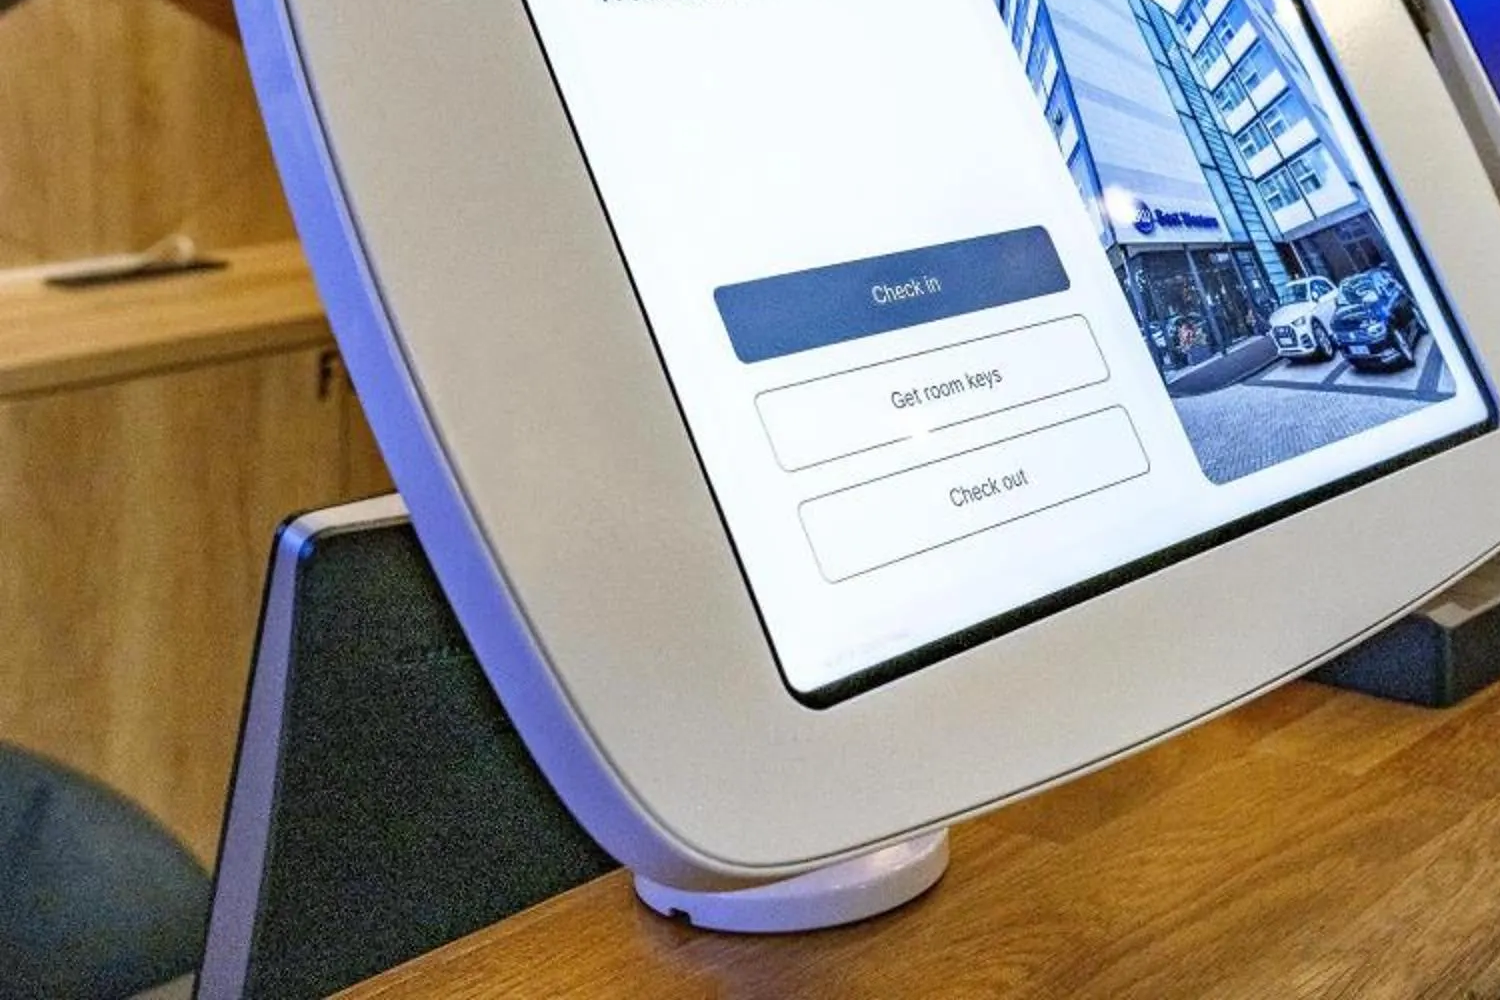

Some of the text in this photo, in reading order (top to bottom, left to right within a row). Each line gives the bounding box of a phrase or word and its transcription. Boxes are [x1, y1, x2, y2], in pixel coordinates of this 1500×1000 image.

[871, 276, 942, 304] Check in
[891, 369, 1003, 409] Get room keys
[949, 468, 1029, 507] Check out
